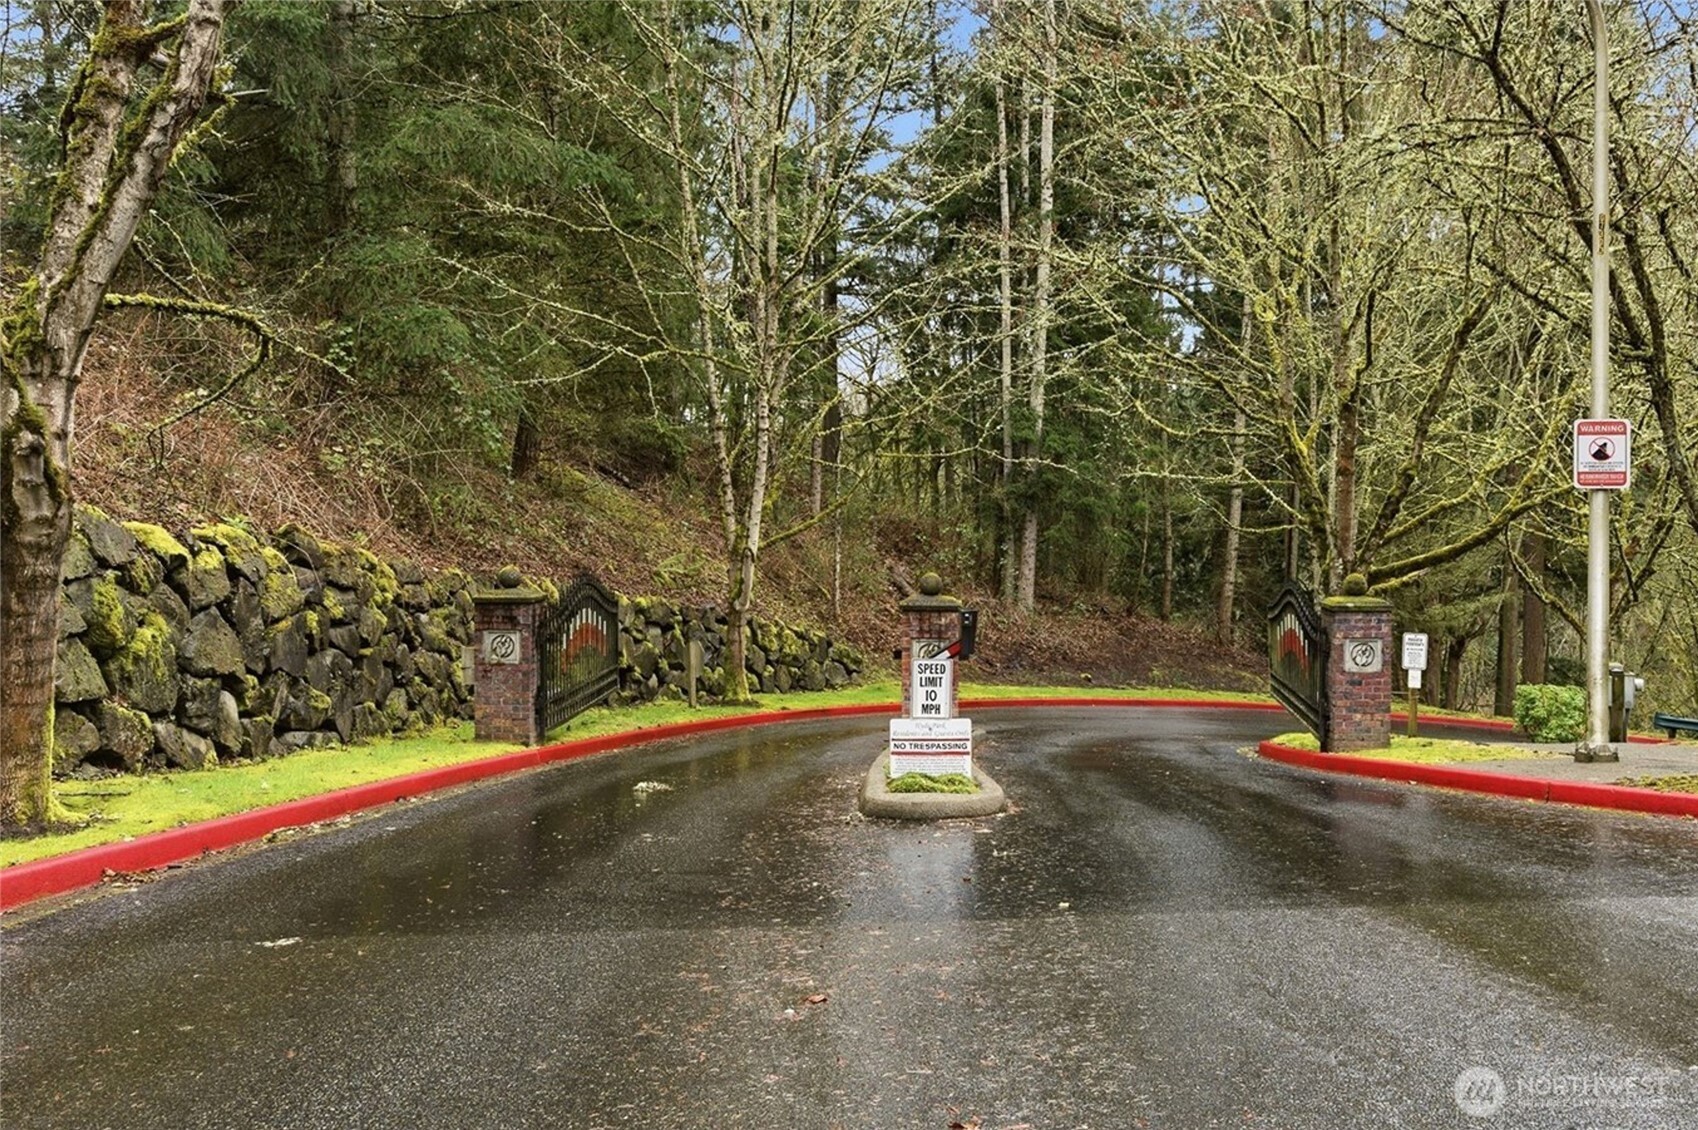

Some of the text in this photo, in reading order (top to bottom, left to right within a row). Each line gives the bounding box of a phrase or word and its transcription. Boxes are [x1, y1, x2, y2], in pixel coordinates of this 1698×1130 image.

[917, 663, 946, 675] SPEED
[919, 676, 943, 688] LIMIT
[925, 689, 938, 701] 10
[921, 703, 941, 715] MPH
[893, 742, 968, 750] NO TRESPASSING
